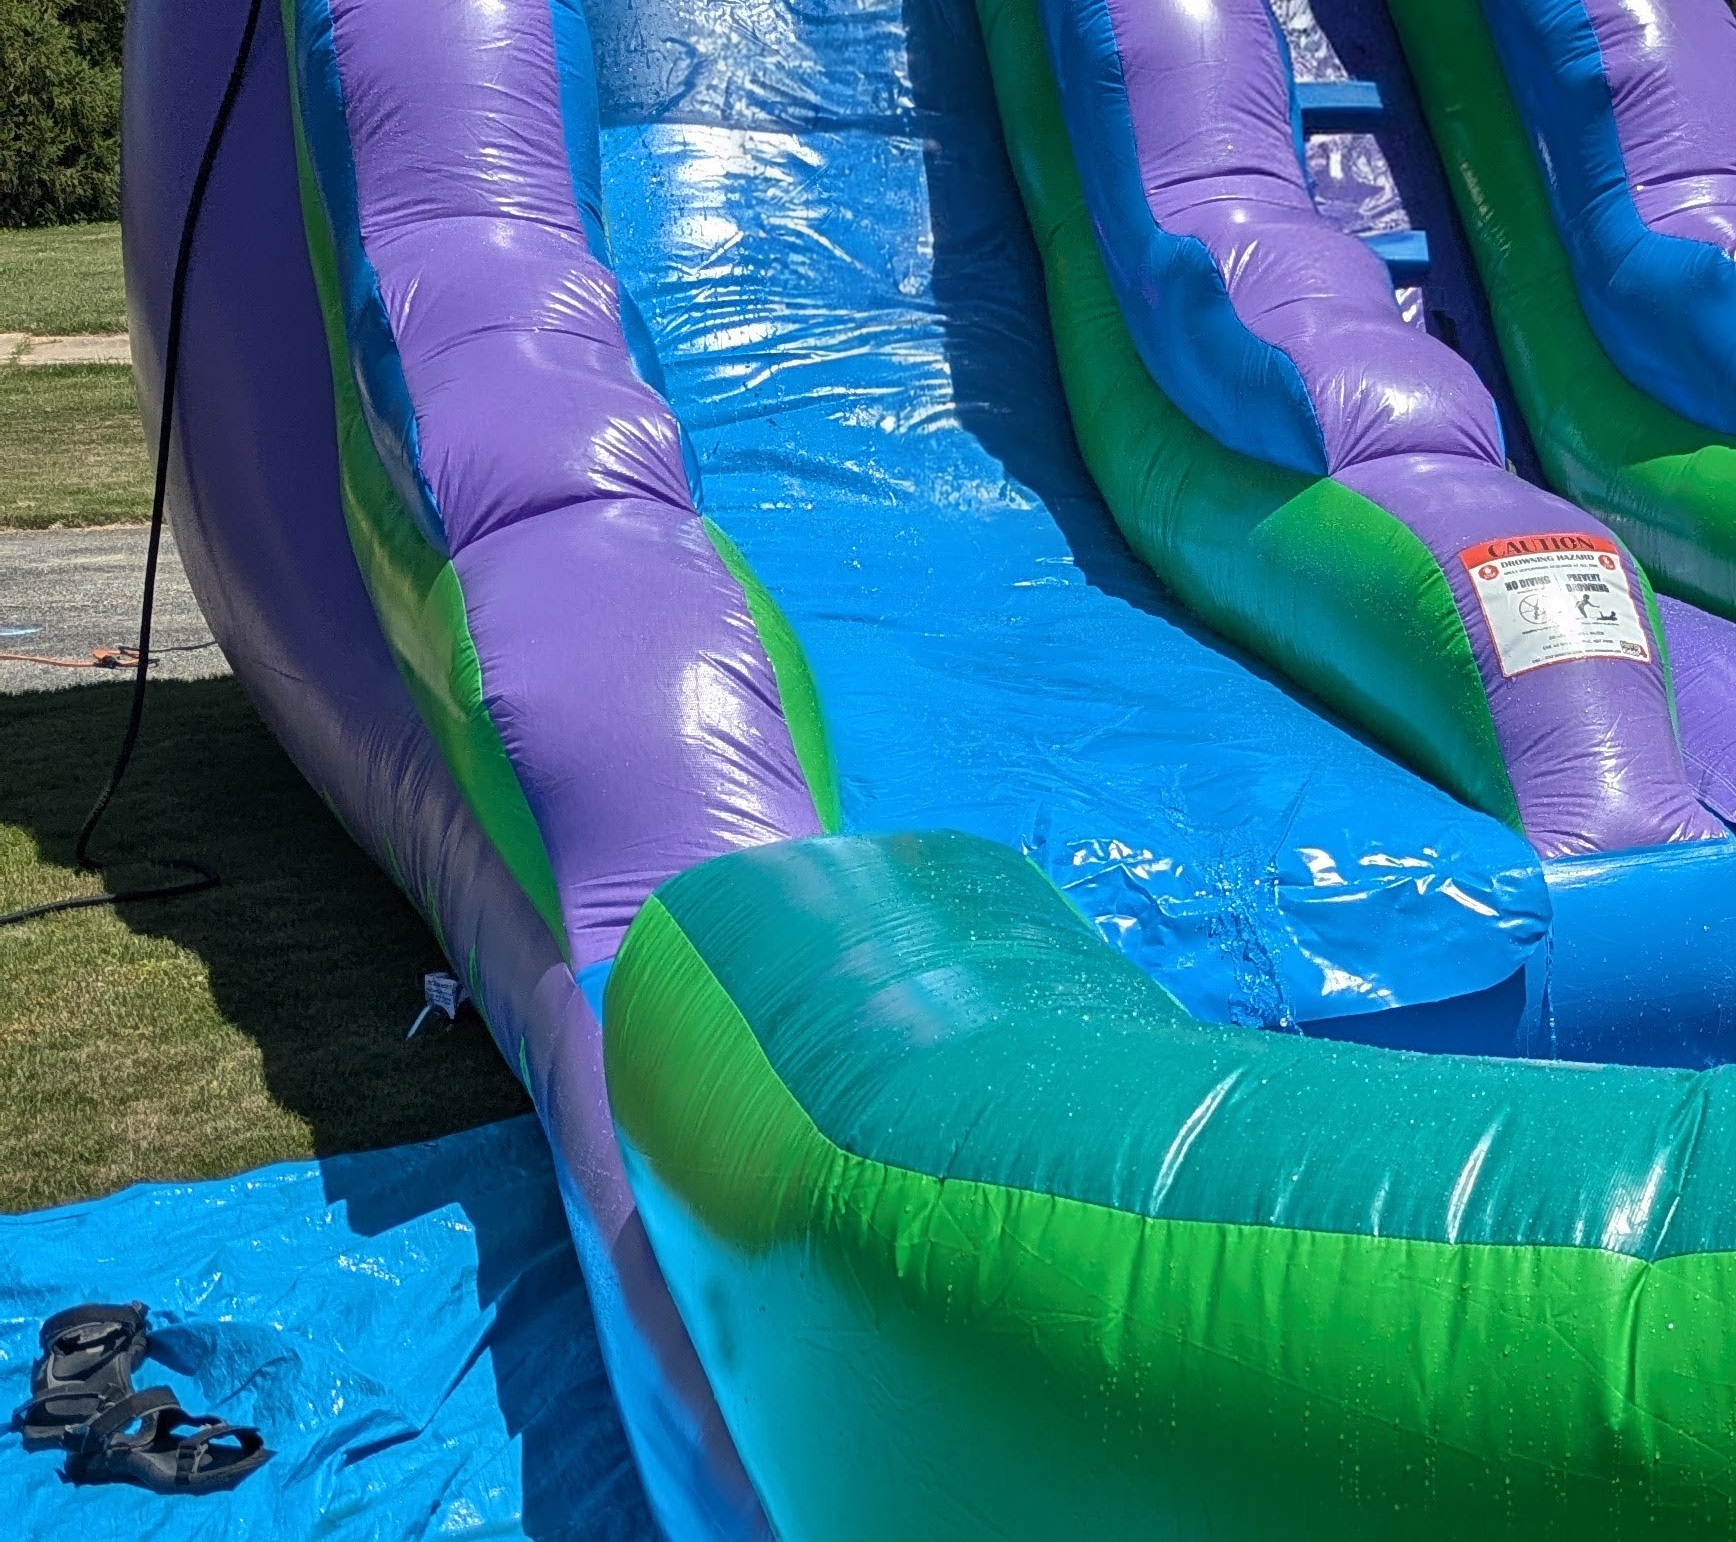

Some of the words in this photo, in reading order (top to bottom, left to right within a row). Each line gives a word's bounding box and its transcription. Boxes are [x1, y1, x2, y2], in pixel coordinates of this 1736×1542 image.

[1487, 536, 1595, 558] CAUTION
[1500, 555, 1554, 568] DROWNING
[1504, 581, 1519, 592] NO
[1519, 575, 1551, 588] DIVING
[1566, 573, 1601, 583] PREVENT
